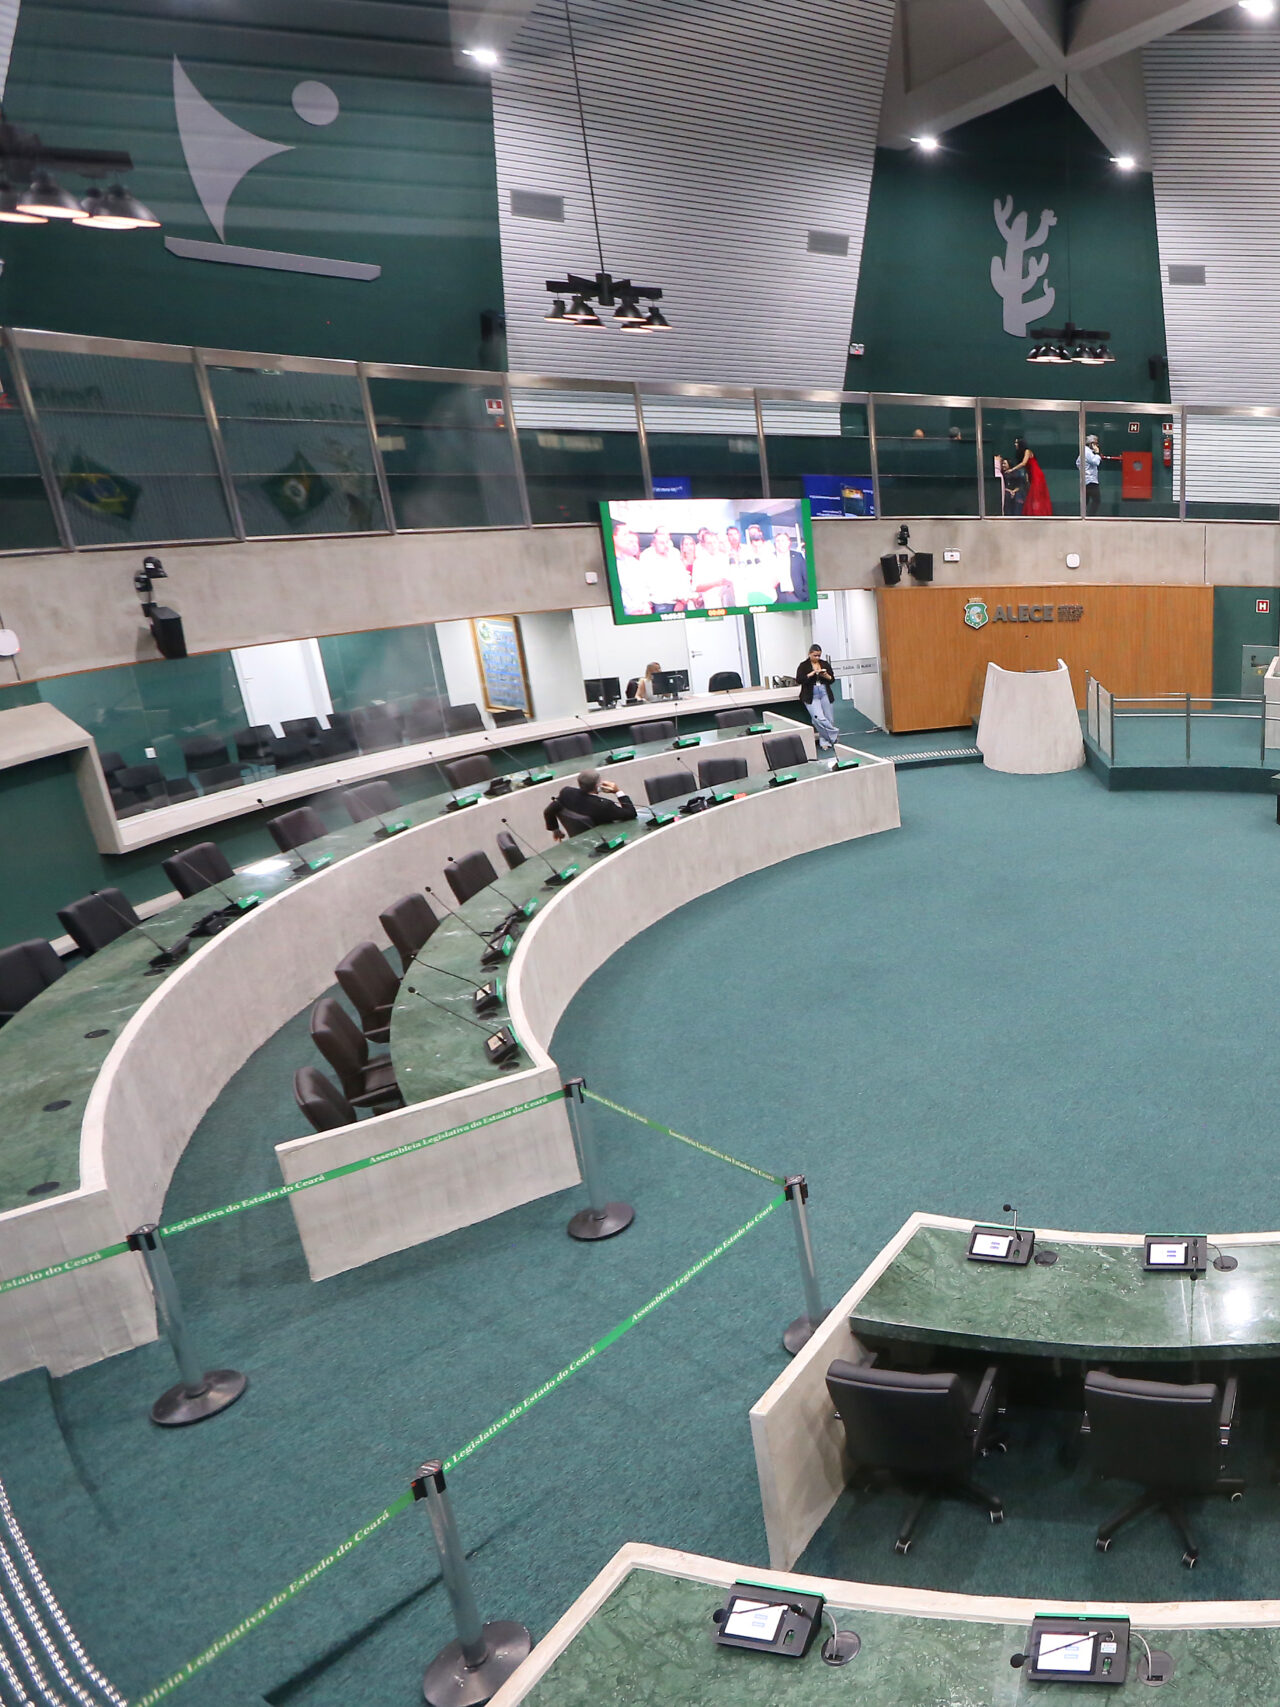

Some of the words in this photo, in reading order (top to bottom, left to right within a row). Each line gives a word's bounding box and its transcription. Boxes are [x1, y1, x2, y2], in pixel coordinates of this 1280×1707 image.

[992, 604, 1054, 622] ALECE
[368, 1141, 422, 1164] Assembleia
[422, 1124, 470, 1145] Legislativa
[470, 1120, 482, 1129] do
[483, 1109, 512, 1124] Estado
[512, 1105, 524, 1114] do
[524, 1097, 548, 1110] Ceará
[162, 1209, 225, 1235] Legislativa
[225, 1203, 240, 1214] do
[242, 1190, 278, 1207] Estado
[280, 1185, 294, 1194] do
[295, 1173, 325, 1189] Ceará
[45, 1266, 62, 1277] do
[64, 1251, 102, 1270] Ceará
[631, 1285, 675, 1322] Assembleia
[675, 1253, 713, 1288] Legislativa
[713, 1245, 723, 1256] do
[723, 1228, 745, 1248] Estado
[745, 1221, 755, 1231] do
[754, 1203, 774, 1222] Ceará
[452, 1417, 508, 1462] Legislativa
[509, 1406, 522, 1419] do
[523, 1380, 555, 1408] Estado
[556, 1369, 569, 1382] do
[569, 1347, 596, 1371] Ceará
[186, 1609, 266, 1674] Legislativa
[268, 1592, 287, 1610] do
[289, 1554, 334, 1594] Estado
[336, 1541, 353, 1557] do
[354, 1509, 390, 1542] Ceará
